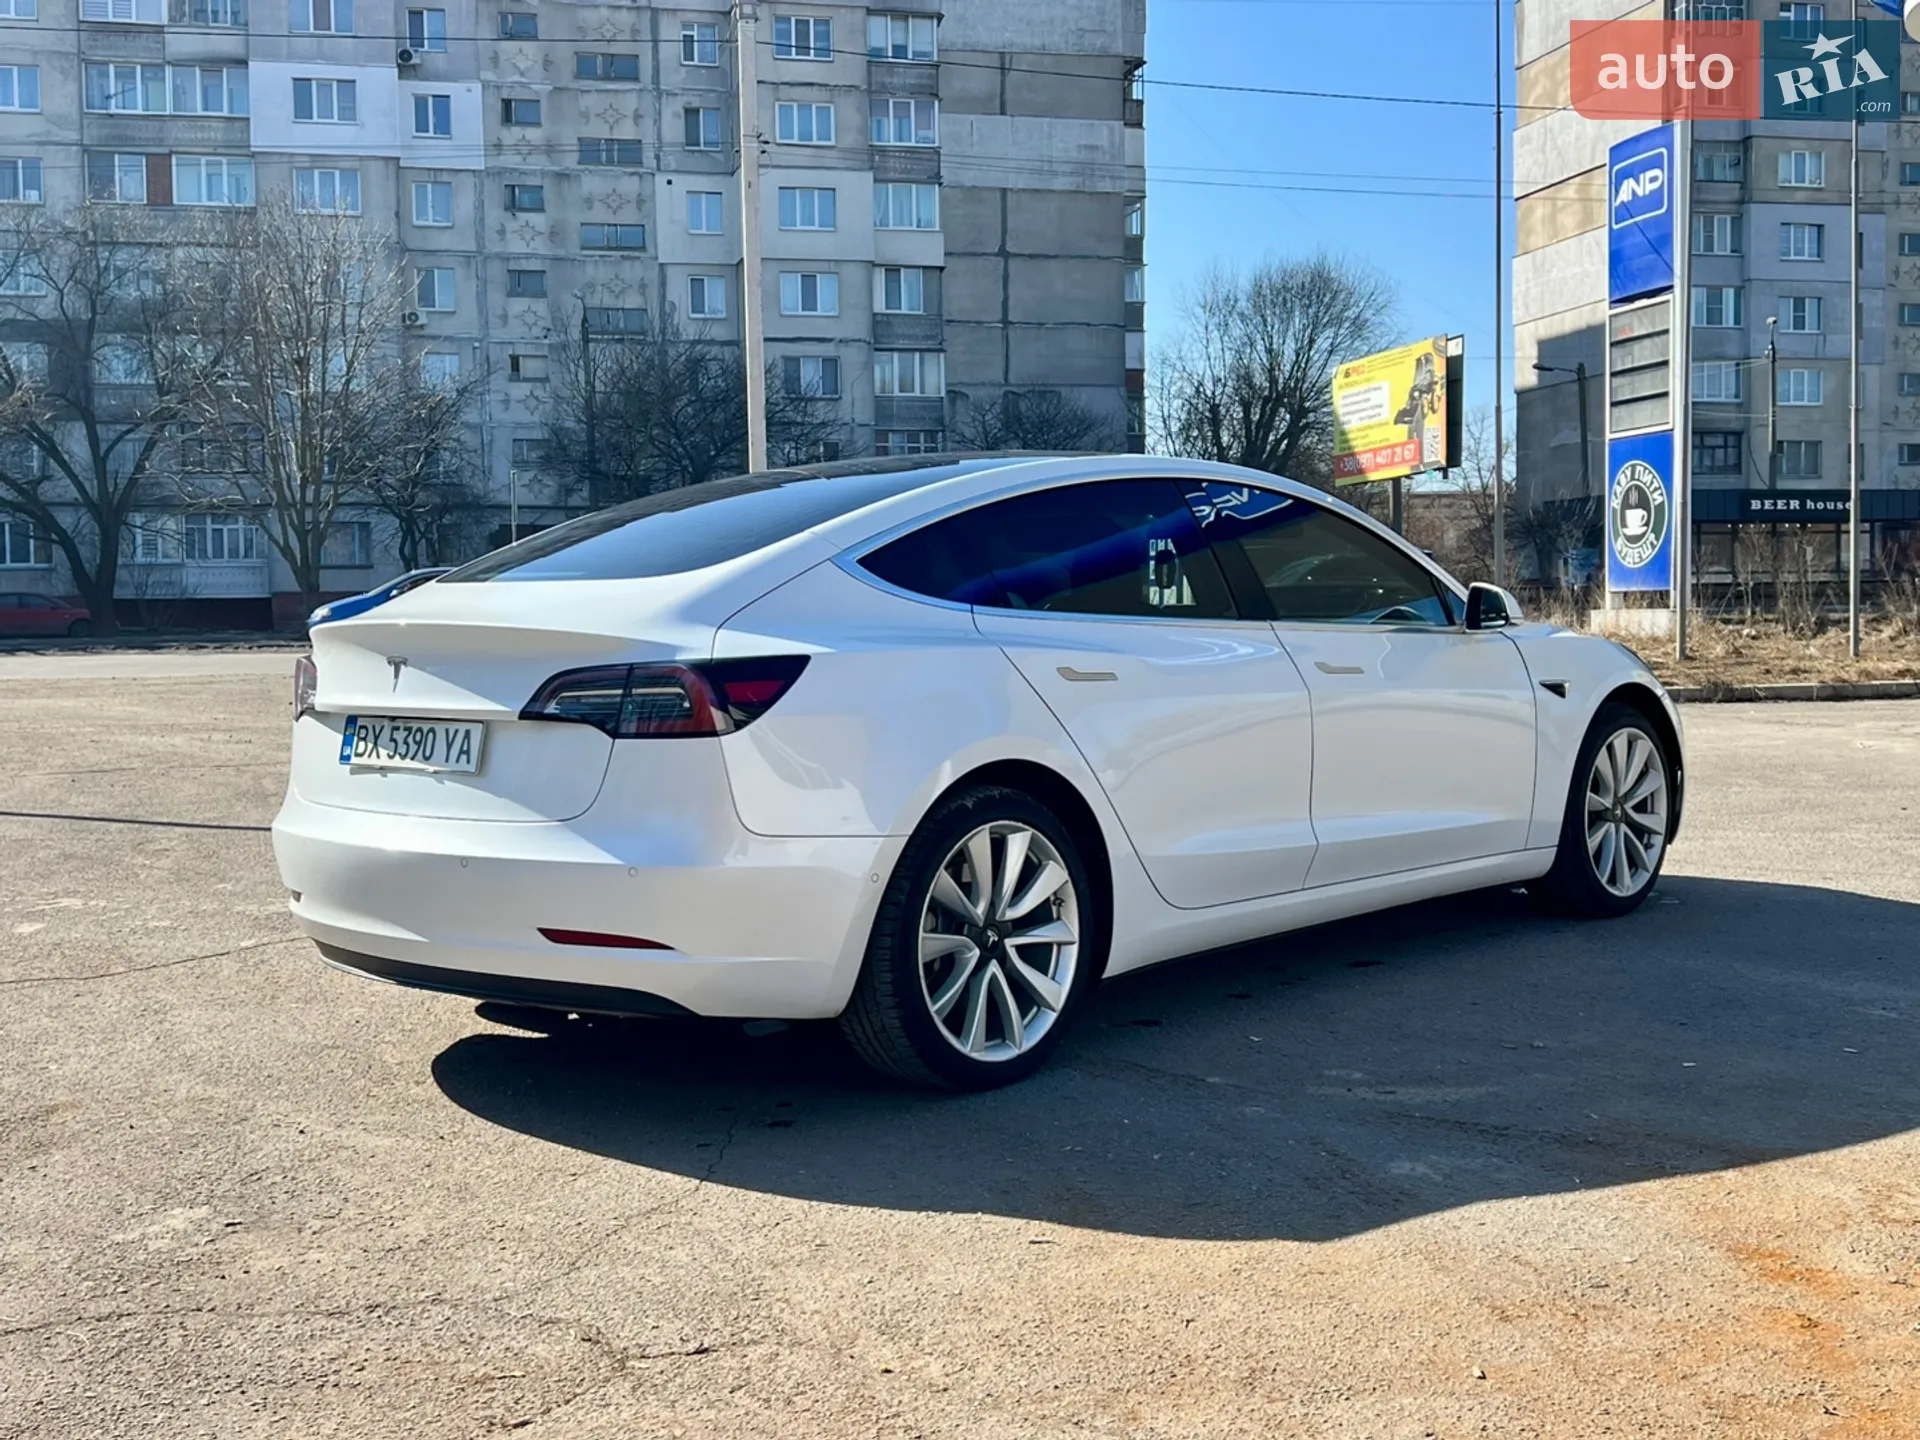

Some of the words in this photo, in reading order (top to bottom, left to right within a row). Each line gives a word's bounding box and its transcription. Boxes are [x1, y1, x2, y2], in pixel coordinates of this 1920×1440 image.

[1614, 168, 1663, 207] ANP
[1635, 465, 1664, 506] ПИТИ
[1750, 499, 1801, 510] BEER
[354, 724, 385, 759] BX
[387, 726, 437, 761] 5390
[445, 728, 471, 764] YA
